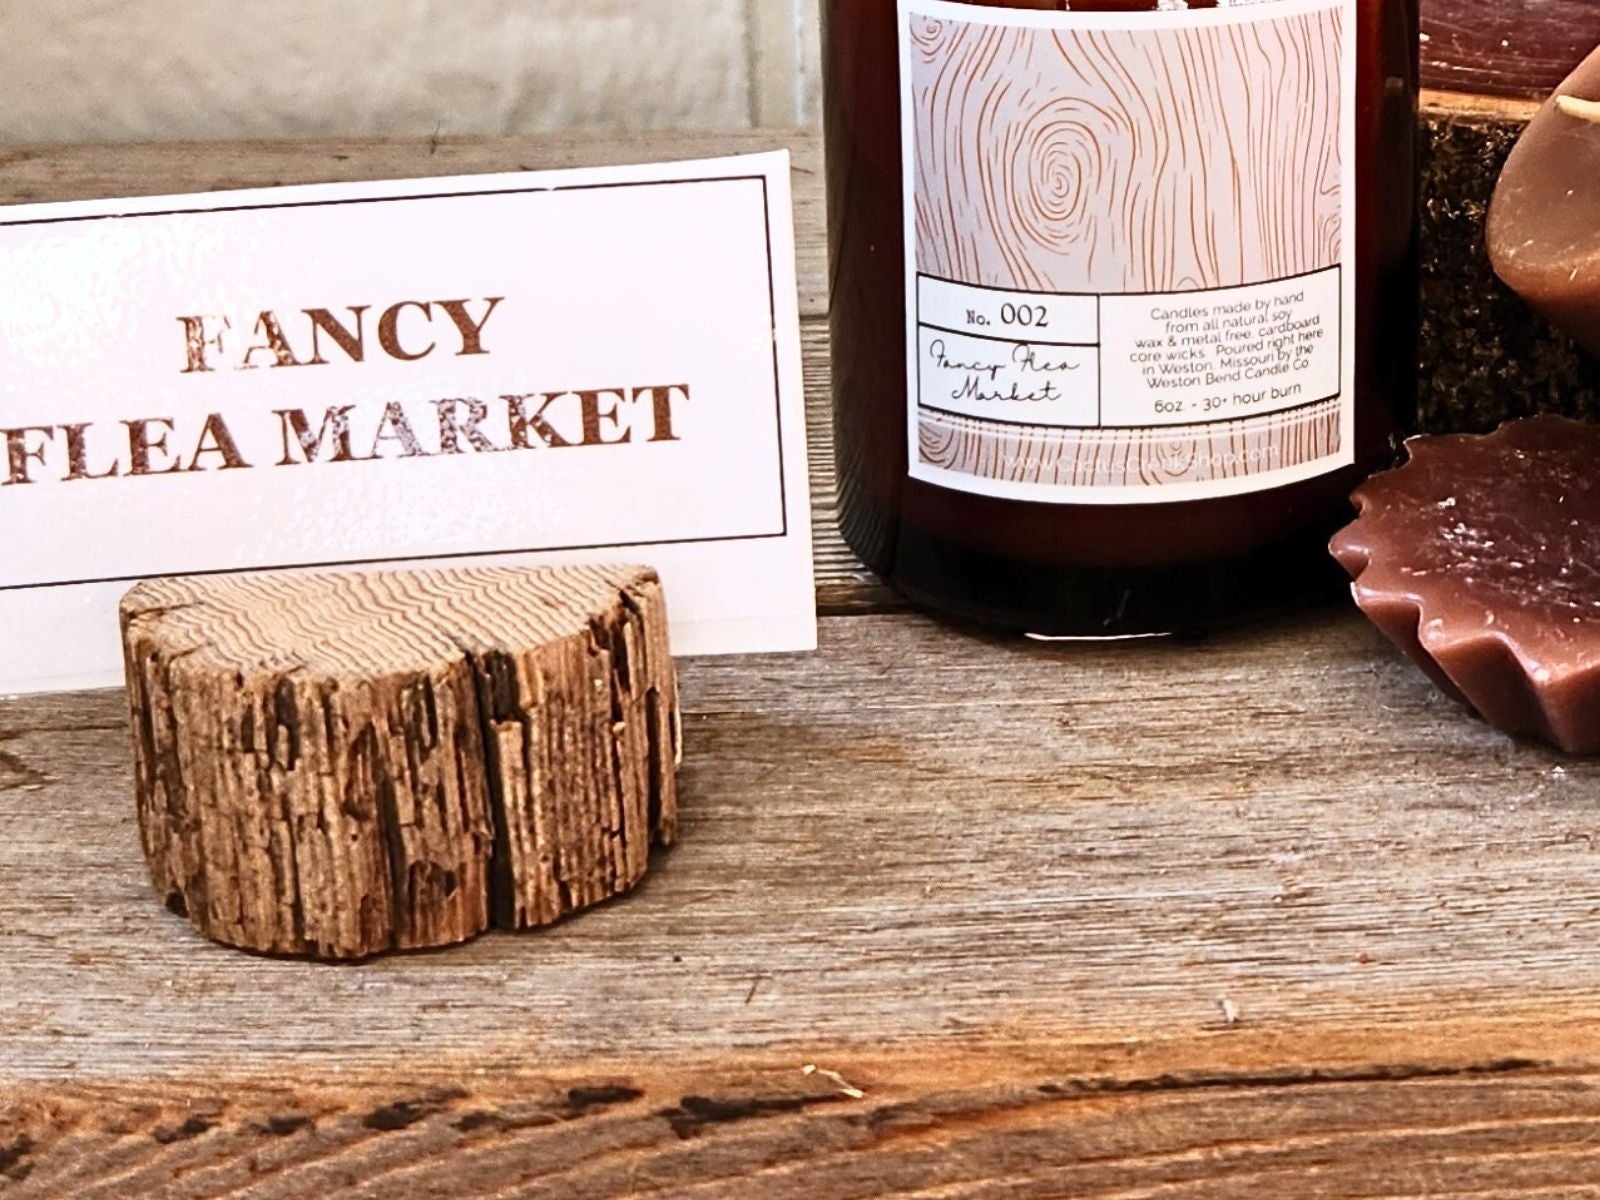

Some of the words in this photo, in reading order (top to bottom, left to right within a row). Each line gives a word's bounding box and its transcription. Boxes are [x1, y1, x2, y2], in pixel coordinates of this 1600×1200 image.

[966, 309, 991, 326] No.
[1000, 302, 1049, 328] 002
[1150, 305, 1208, 320] Candles
[1213, 302, 1251, 315] made
[1255, 299, 1271, 322] by
[1274, 290, 1303, 306] hand
[1166, 321, 1199, 333] from
[1203, 318, 1219, 331] all
[1222, 314, 1267, 328] natural
[1272, 308, 1292, 328] soy
[176, 296, 504, 373] FANCY
[1129, 352, 1162, 362] core
[1216, 340, 1264, 356] Poured
[1267, 333, 1294, 354] right
[1298, 327, 1324, 342] here
[1135, 339, 1162, 348] wax
[1167, 335, 1177, 347] &
[1181, 331, 1221, 345] metal
[1258, 314, 1320, 337] cardboard
[930, 339, 1006, 380] Fancy
[1012, 343, 1080, 372] Flea
[1142, 366, 1155, 375] in
[1220, 353, 1274, 368] Missouri
[1277, 349, 1292, 363] by
[1296, 344, 1313, 357] the
[952, 375, 1062, 401] Market
[1146, 375, 1201, 389] Weston
[1206, 370, 1241, 385] Bend
[1244, 362, 1289, 380] Candle
[1233, 390, 1266, 405] hour
[1271, 383, 1302, 400] burn
[0, 412, 253, 485] FLEA
[272, 383, 689, 466] MARKET
